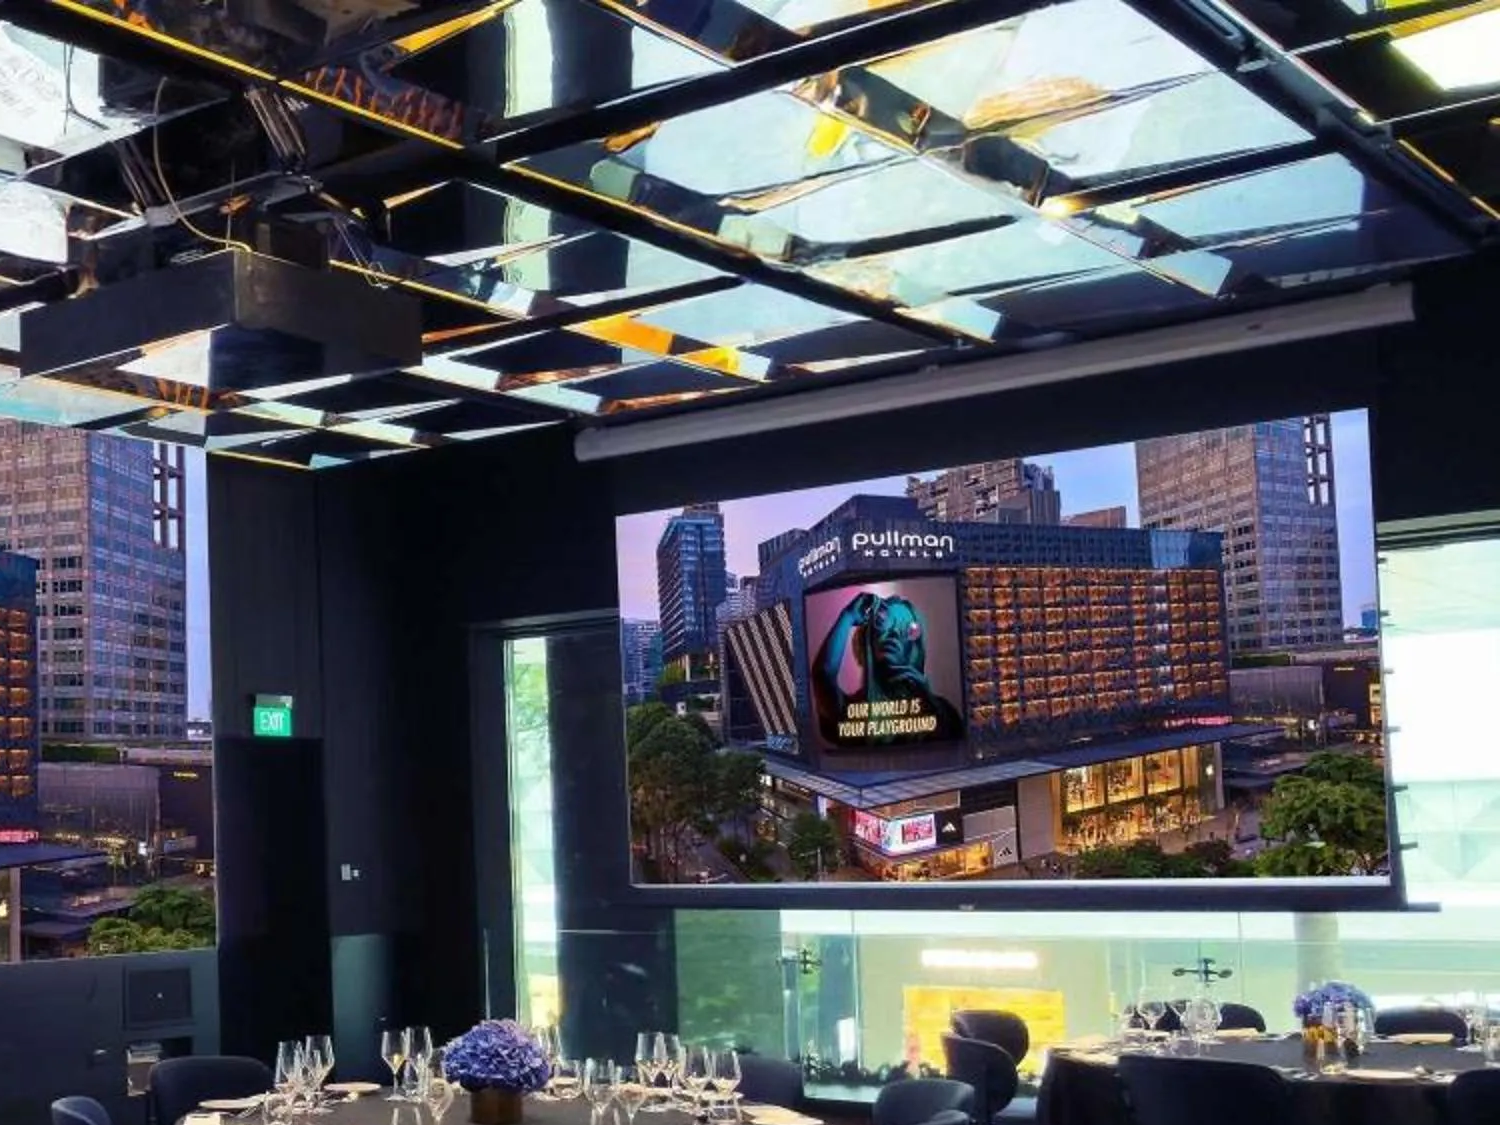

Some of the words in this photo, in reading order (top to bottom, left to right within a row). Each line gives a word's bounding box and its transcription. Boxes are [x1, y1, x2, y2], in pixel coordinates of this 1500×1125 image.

[852, 530, 953, 553] pullman
[847, 703, 869, 719] OUR
[871, 699, 908, 716] WORLD
[910, 697, 921, 714] IS
[260, 711, 285, 731] EXIT
[838, 721, 865, 737] YOUR
[867, 715, 937, 736] PLAYGROUND
